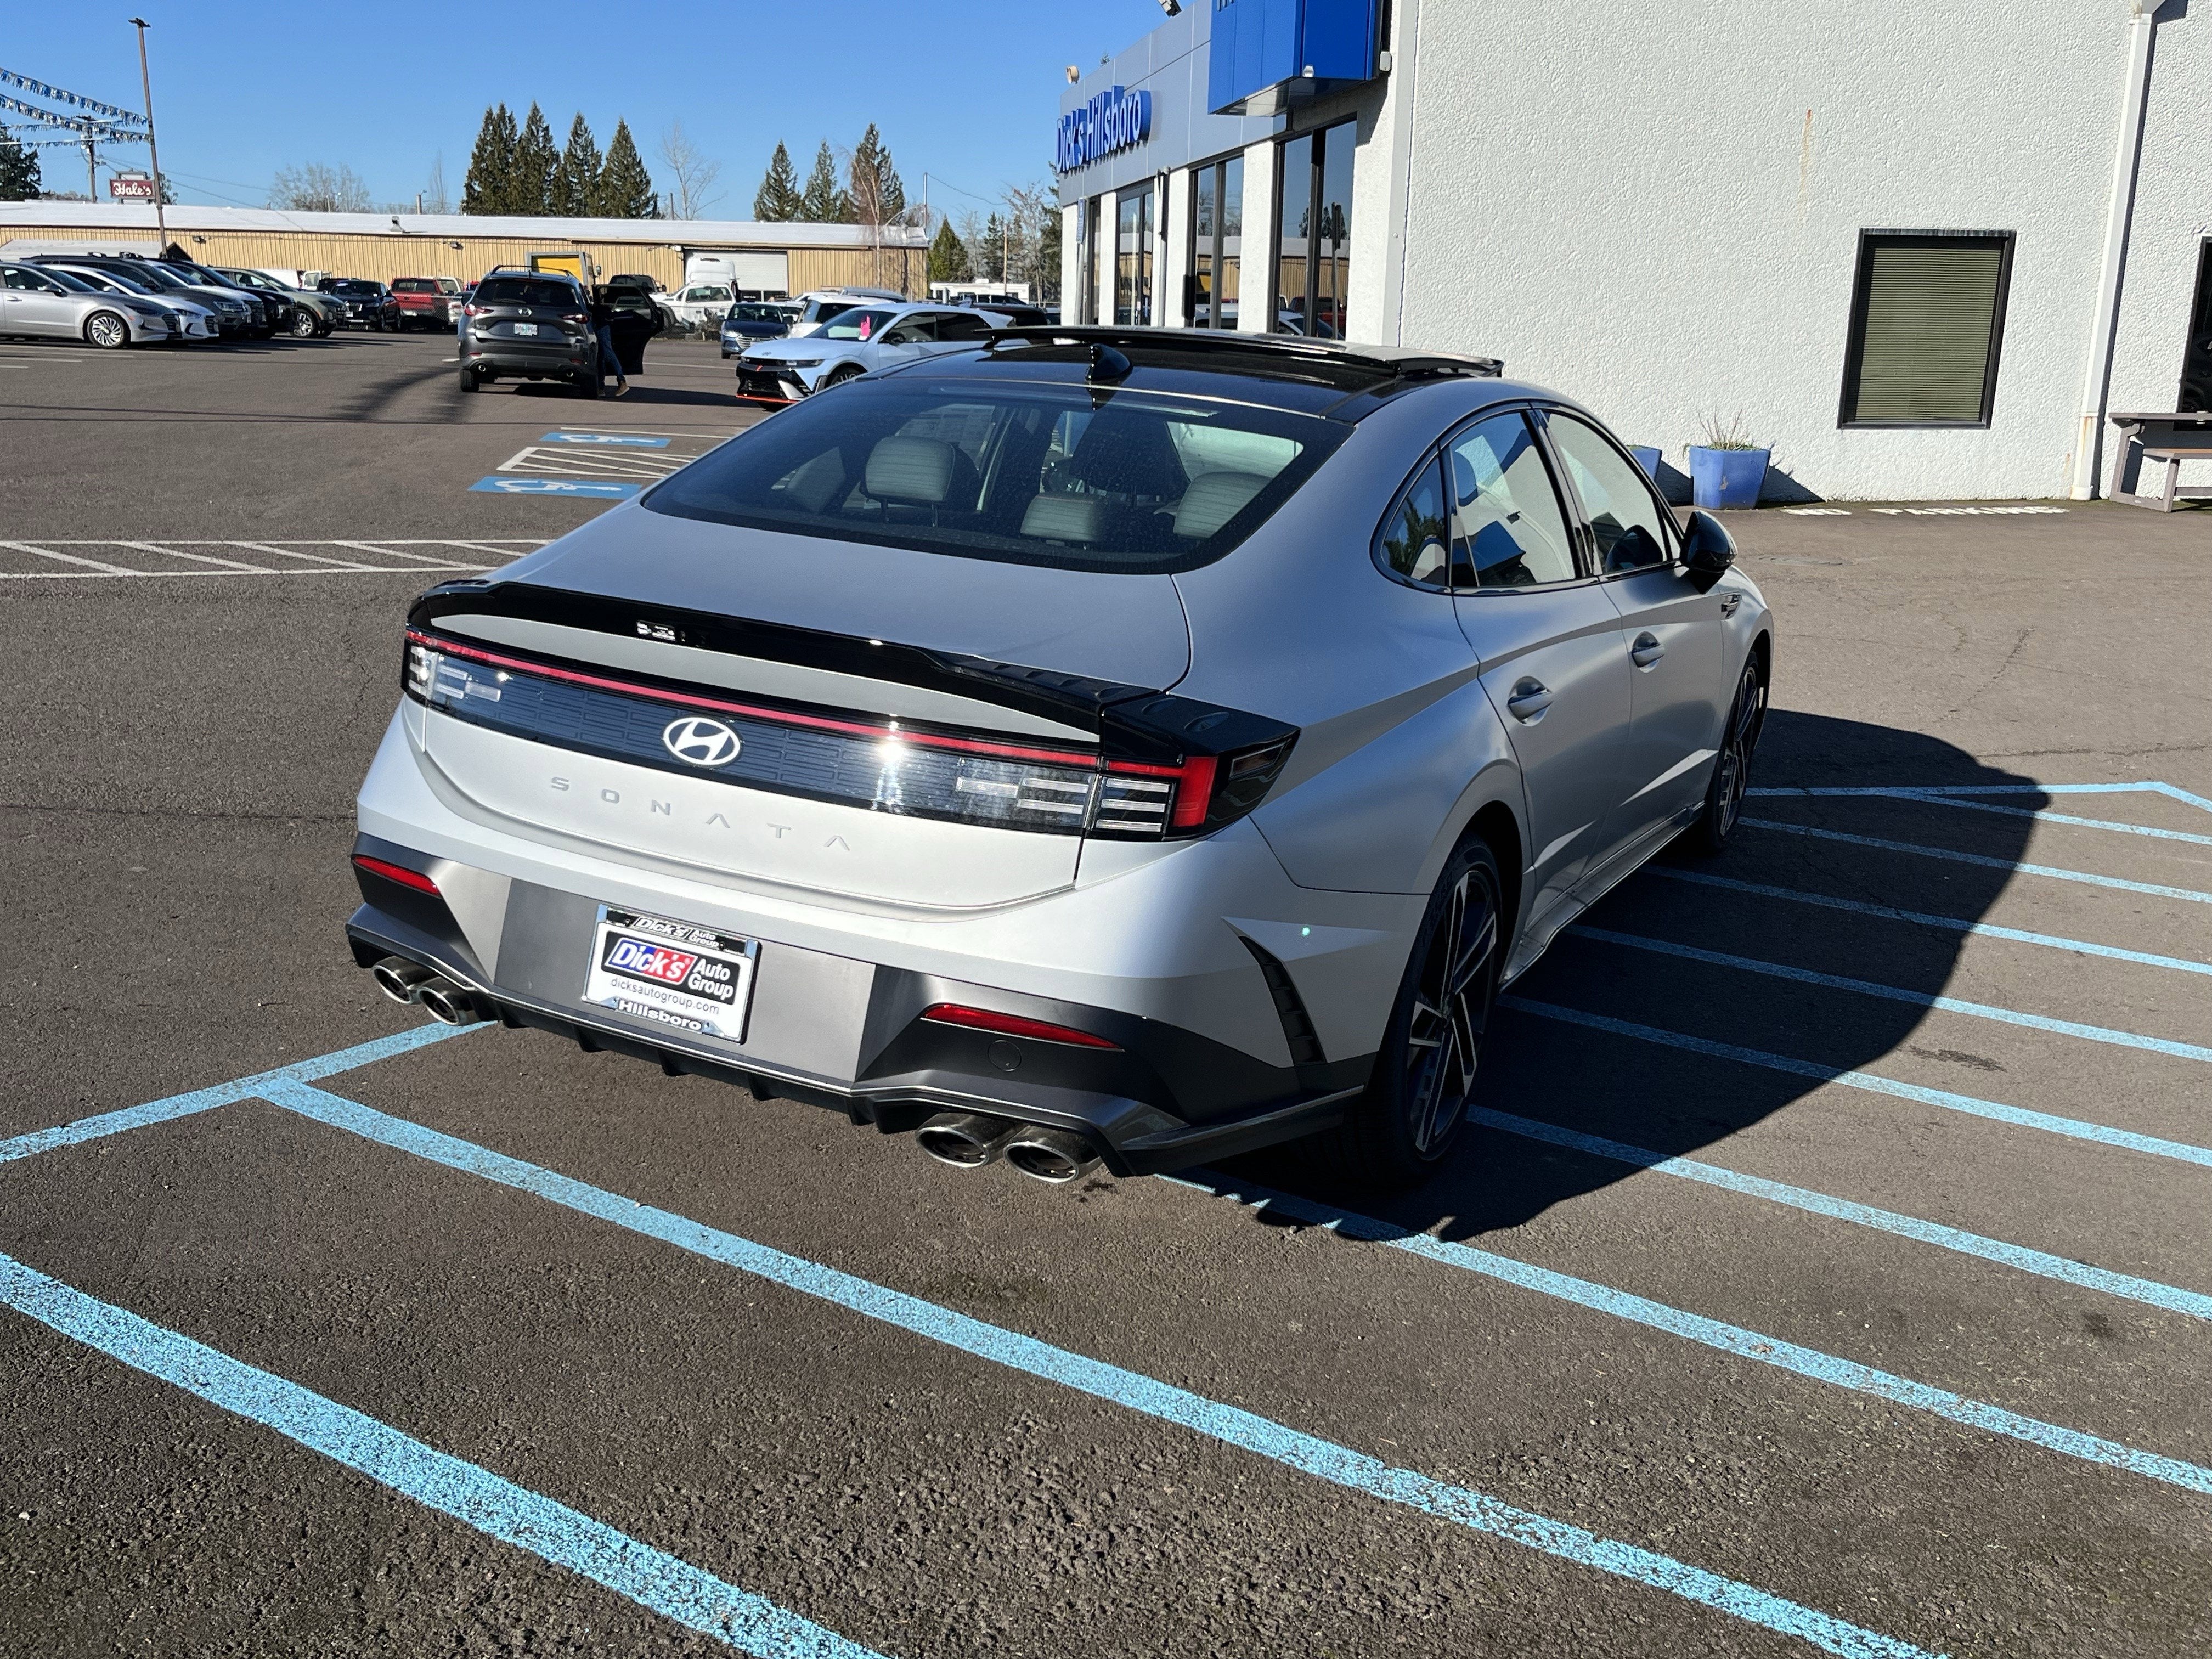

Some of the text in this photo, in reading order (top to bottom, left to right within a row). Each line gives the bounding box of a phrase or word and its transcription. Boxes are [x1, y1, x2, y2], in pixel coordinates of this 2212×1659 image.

[1057, 86, 1144, 173] Dick's Hillsboro
[113, 182, 151, 195] Hale's
[1867, 506, 2070, 516] PARKING
[551, 776, 851, 851] SONATA
[636, 917, 689, 937] Dick's
[691, 929, 716, 940] Auto
[689, 934, 720, 948] Group
[611, 942, 685, 979] Dick's
[692, 958, 731, 981] Auto
[611, 977, 720, 1015] dicksautogroup.com
[687, 973, 734, 1001] Group
[617, 999, 702, 1031] Hillsboro
